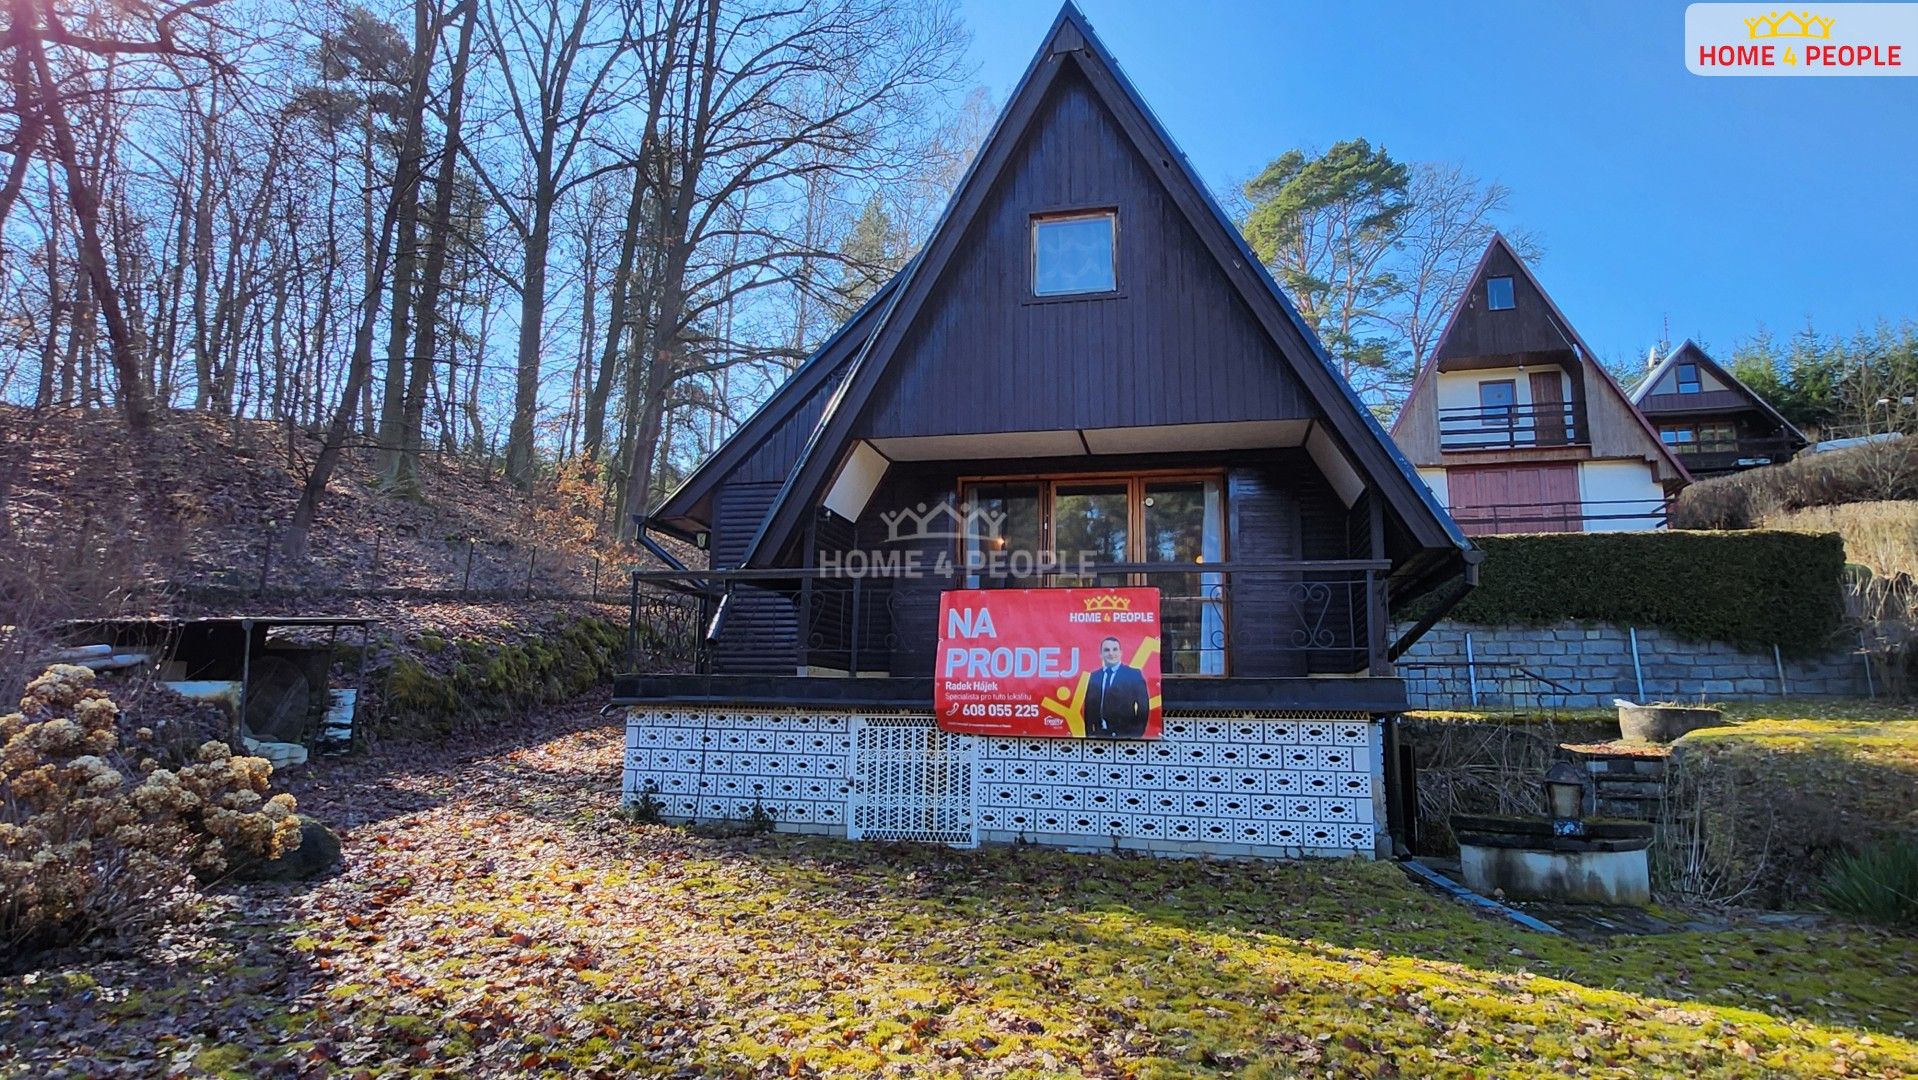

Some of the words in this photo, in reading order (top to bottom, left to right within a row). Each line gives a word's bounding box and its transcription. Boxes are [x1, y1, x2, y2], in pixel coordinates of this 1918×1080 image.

[948, 607, 997, 638] NA
[1069, 612, 1101, 623] HOME
[1103, 612, 1112, 623] 4
[1112, 611, 1154, 623] PEOPLE
[945, 647, 1079, 678] PRODEJ
[945, 681, 972, 691] Radek
[973, 680, 998, 692] Hájek
[945, 692, 979, 701] Specialista
[980, 694, 992, 702] pro
[962, 703, 986, 716] 608
[988, 704, 1012, 717] 055
[1015, 704, 1039, 718] 225
